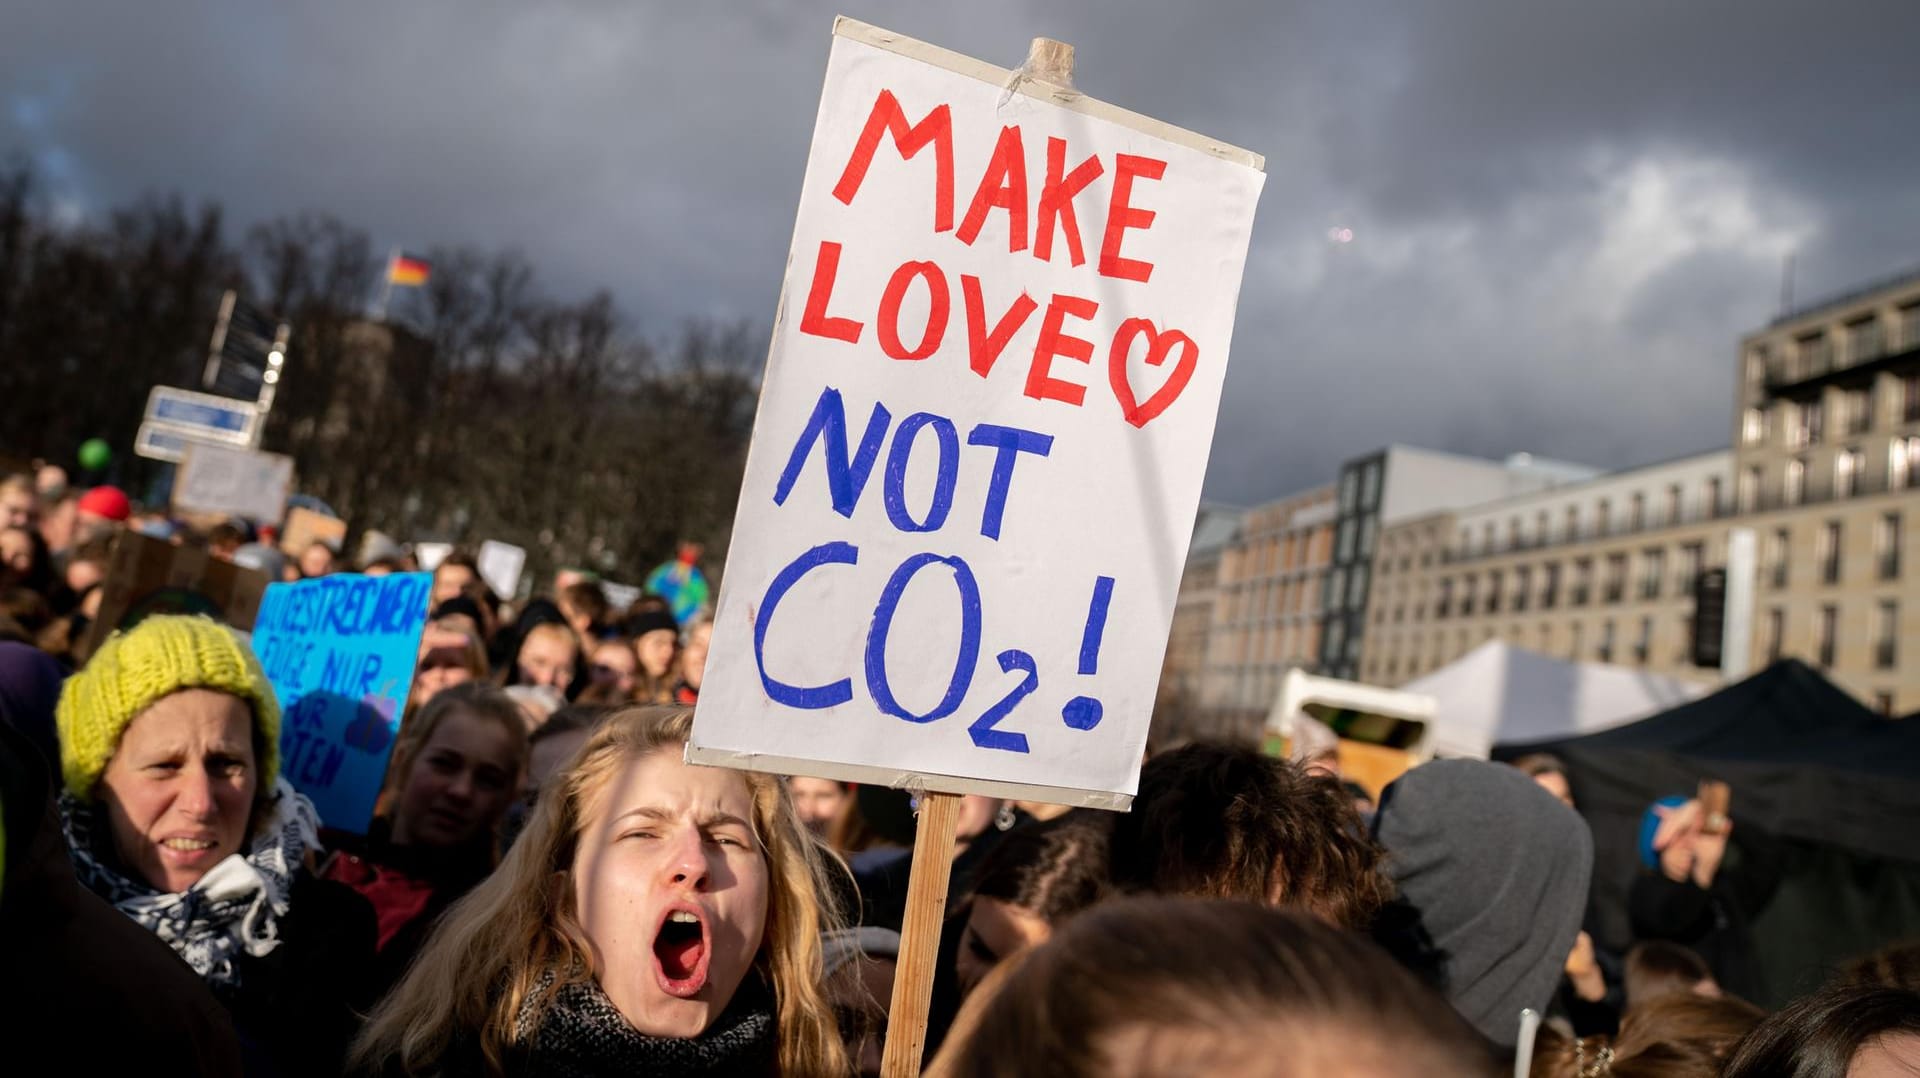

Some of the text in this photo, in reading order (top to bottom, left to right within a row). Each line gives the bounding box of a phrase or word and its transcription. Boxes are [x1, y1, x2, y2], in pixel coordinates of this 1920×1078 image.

[832, 89, 1168, 283] MAKE
[800, 241, 1098, 406] LOVE
[773, 387, 1053, 541] NOT
[319, 647, 382, 698] NUR
